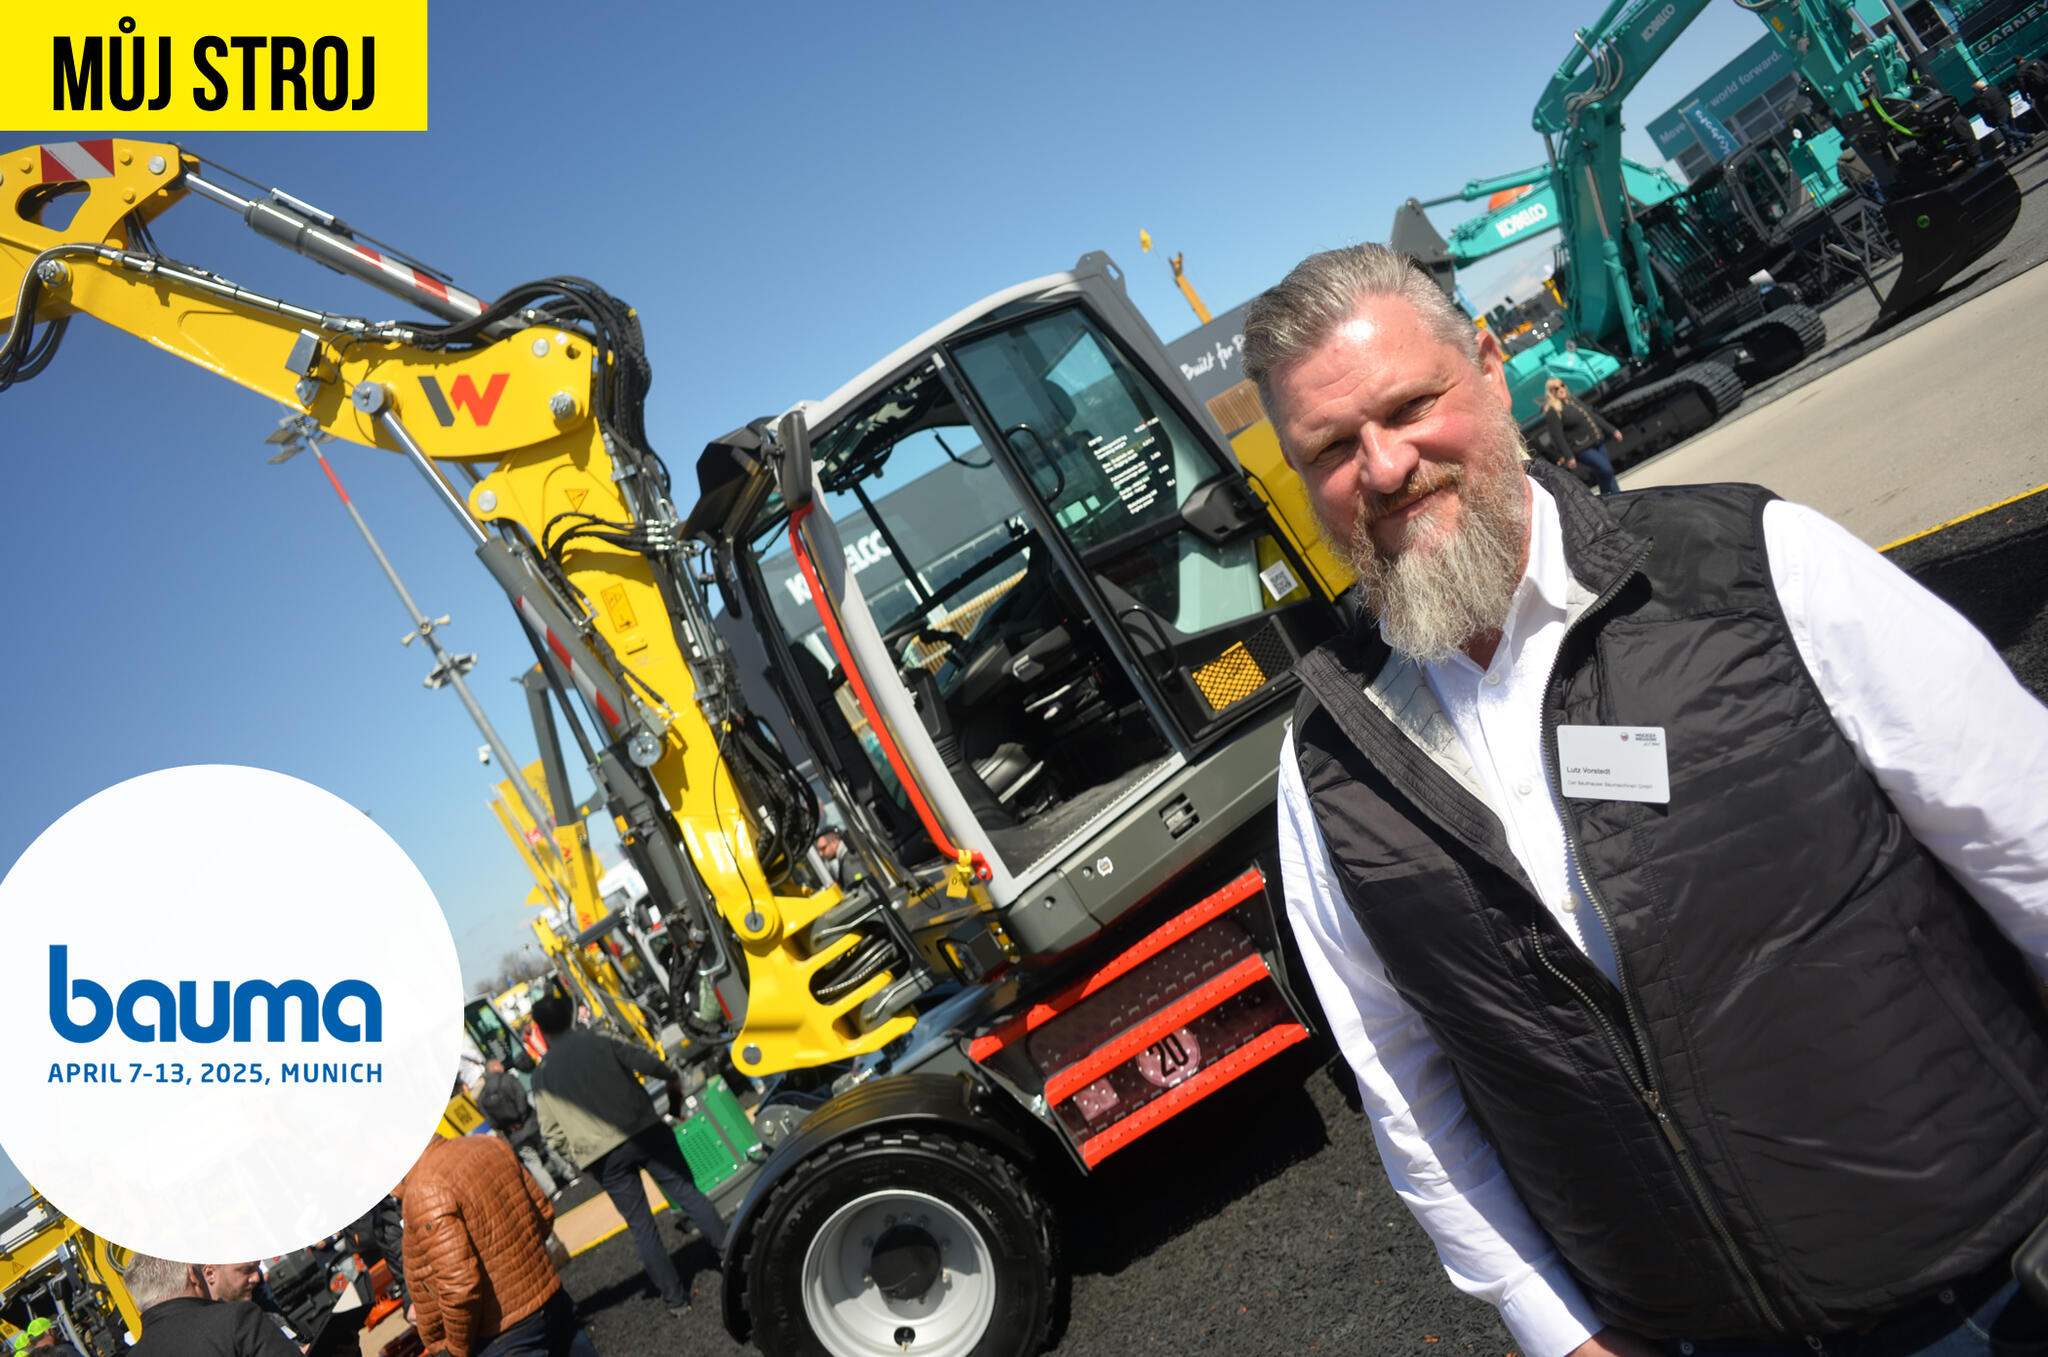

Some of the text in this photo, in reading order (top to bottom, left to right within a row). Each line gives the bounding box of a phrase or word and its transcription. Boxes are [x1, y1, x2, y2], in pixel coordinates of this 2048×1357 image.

[1659, 121, 1686, 145] Move
[1709, 81, 1739, 107] world
[1495, 203, 1548, 239] KOBELCO
[1147, 1033, 1189, 1078] 20
